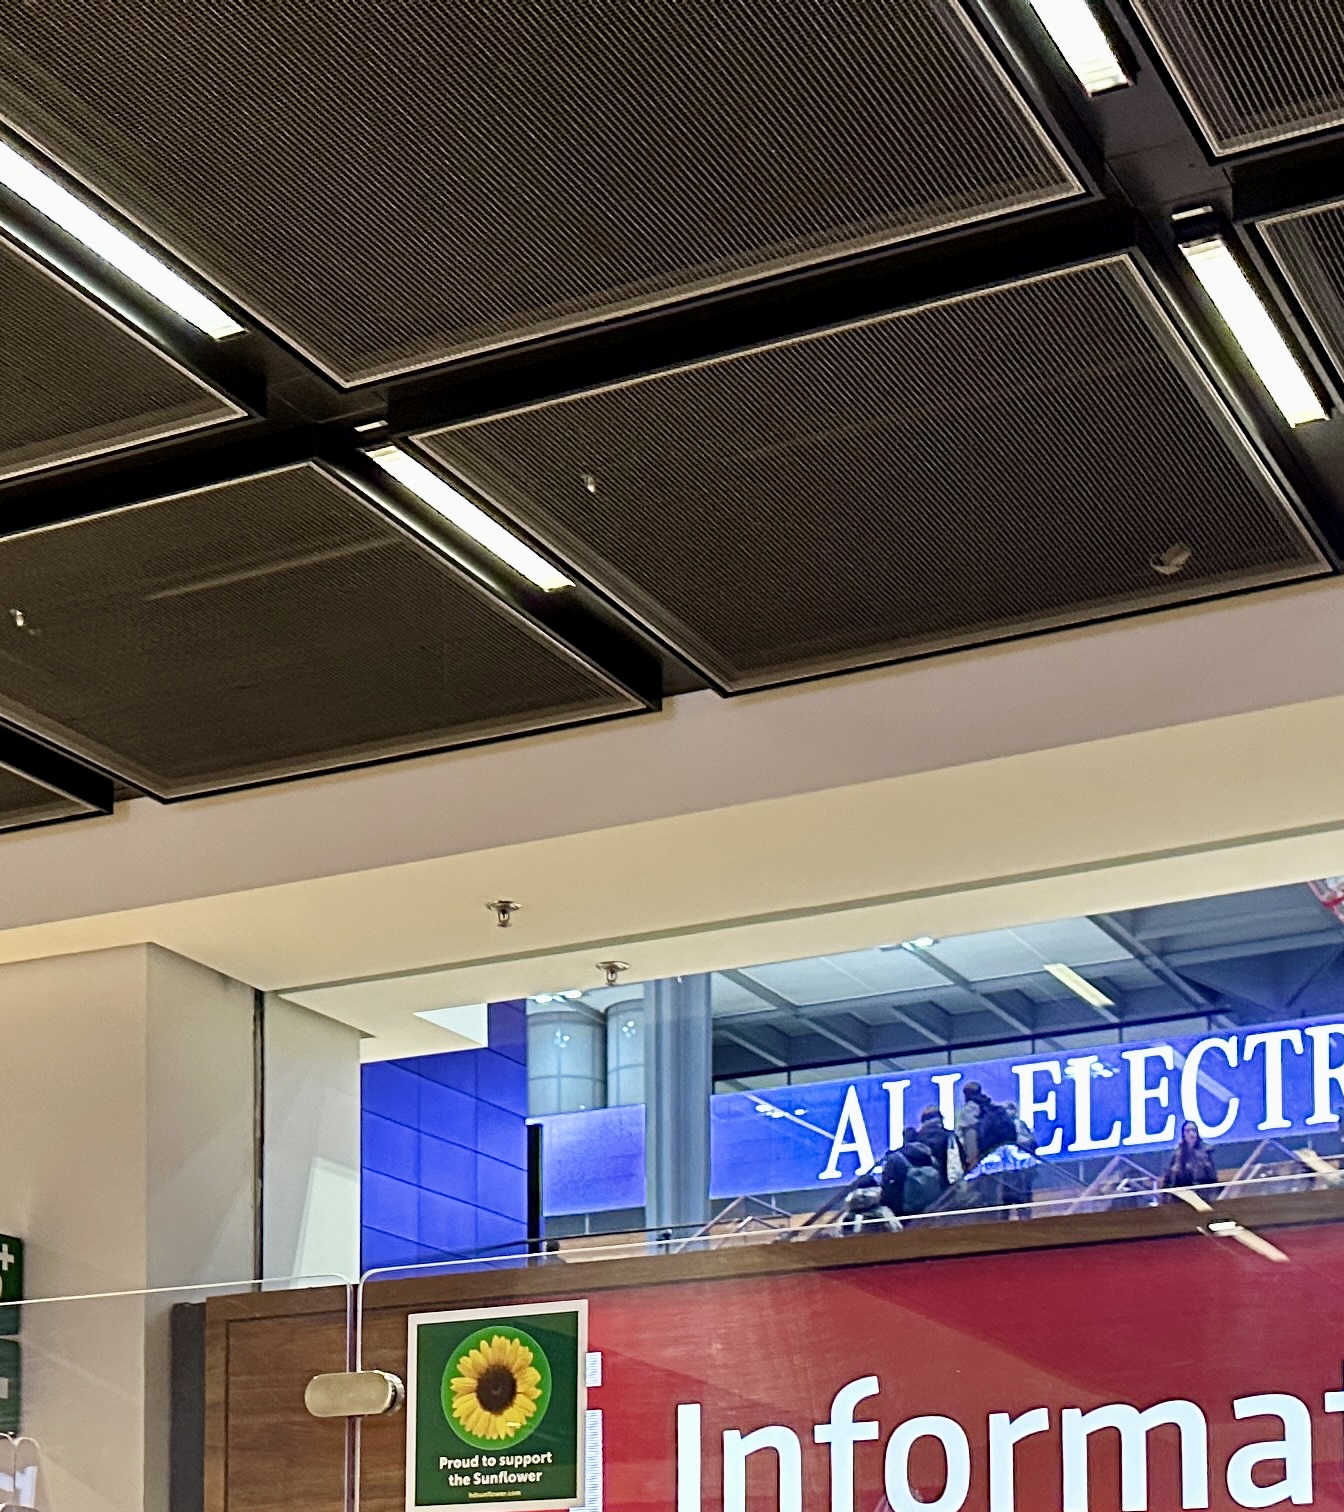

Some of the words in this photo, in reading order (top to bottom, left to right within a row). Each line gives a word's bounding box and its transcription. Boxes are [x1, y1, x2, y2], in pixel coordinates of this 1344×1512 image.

[439, 1454, 479, 1469] Proud
[482, 1455, 496, 1467] to
[499, 1451, 553, 1468] support
[448, 1474, 470, 1486] the
[473, 1471, 542, 1485] Sunflower
